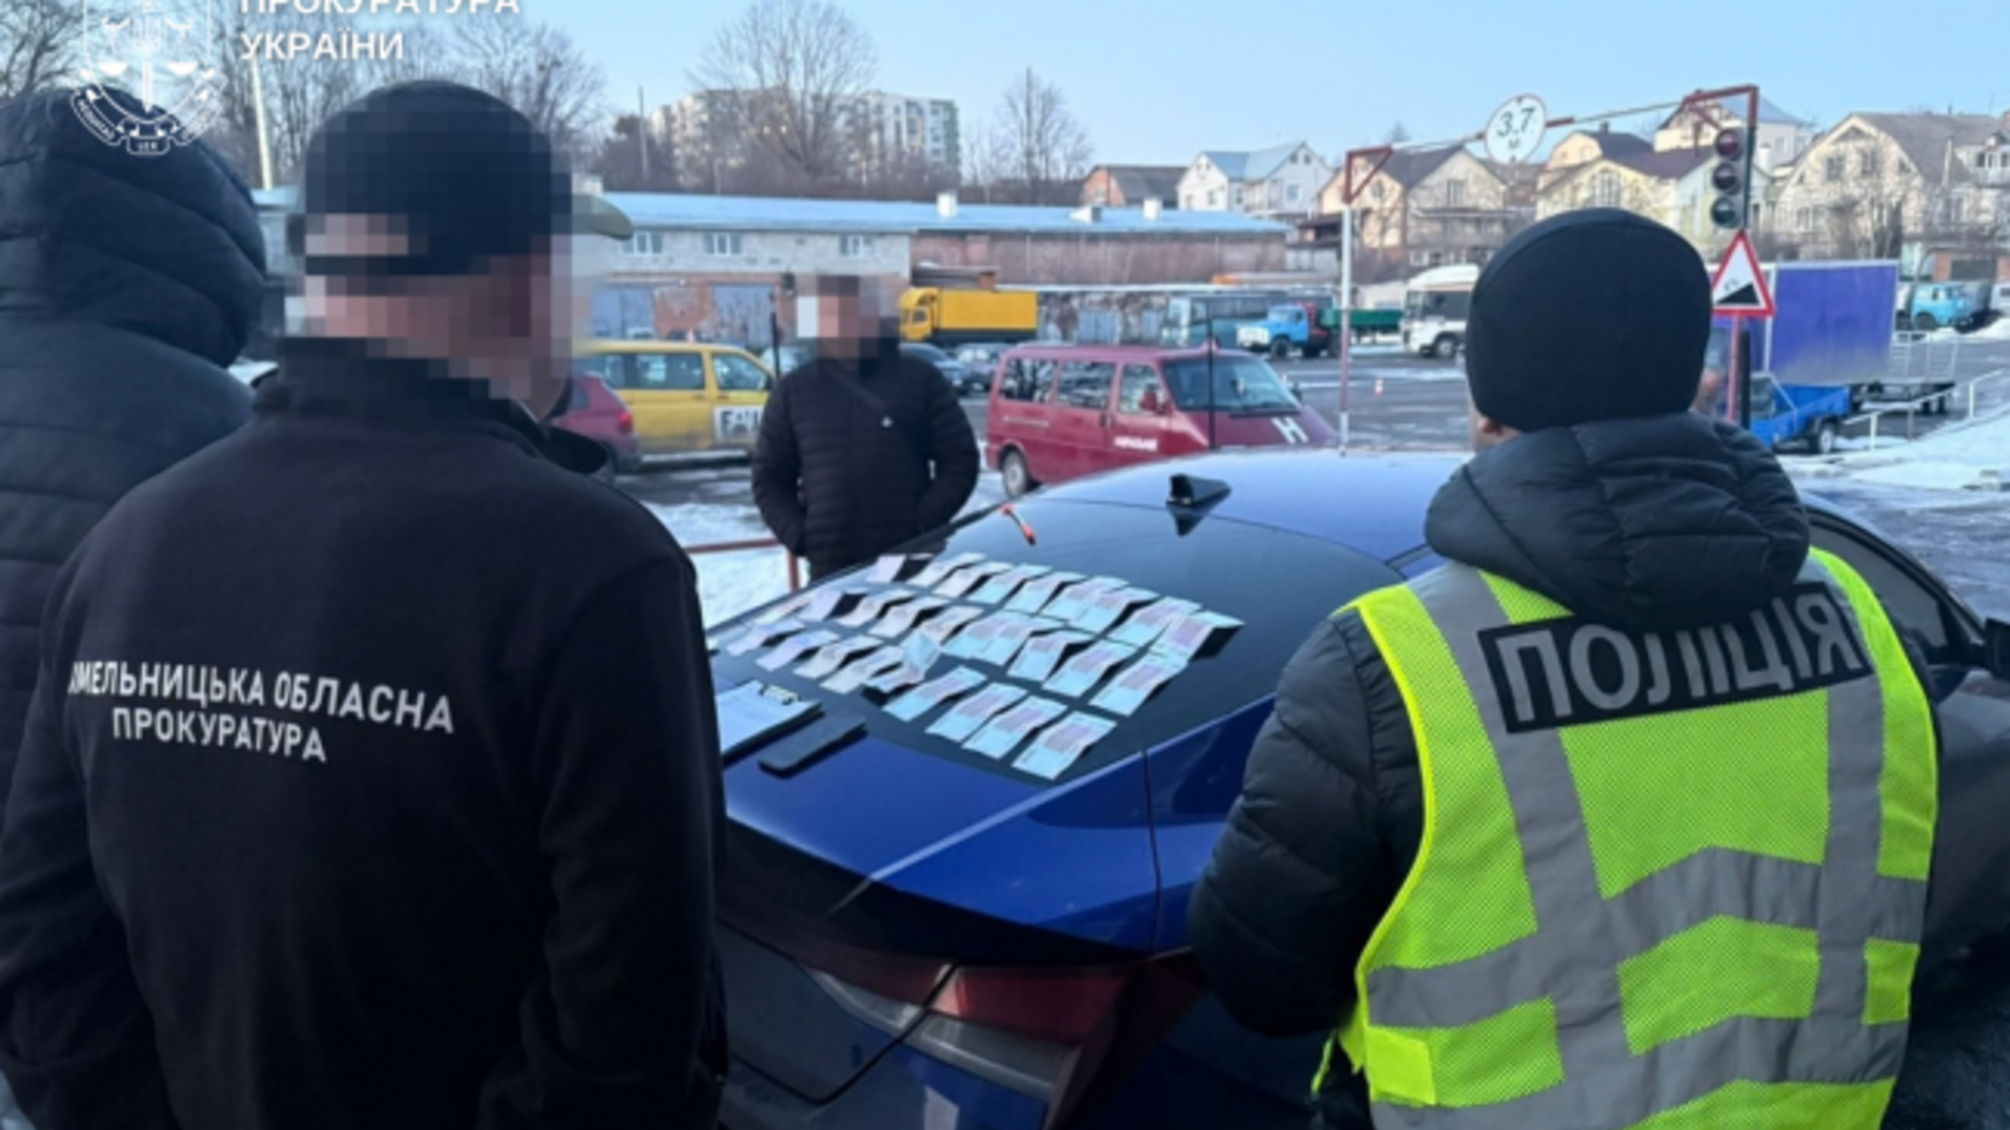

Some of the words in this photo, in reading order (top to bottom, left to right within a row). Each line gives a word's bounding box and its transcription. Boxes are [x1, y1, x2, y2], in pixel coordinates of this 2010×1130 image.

[1495, 592, 1863, 722] ПОЛІЦІЯ
[274, 671, 455, 734] ОБЛАСНА
[112, 707, 327, 762] ПРОКУРАТУРА
